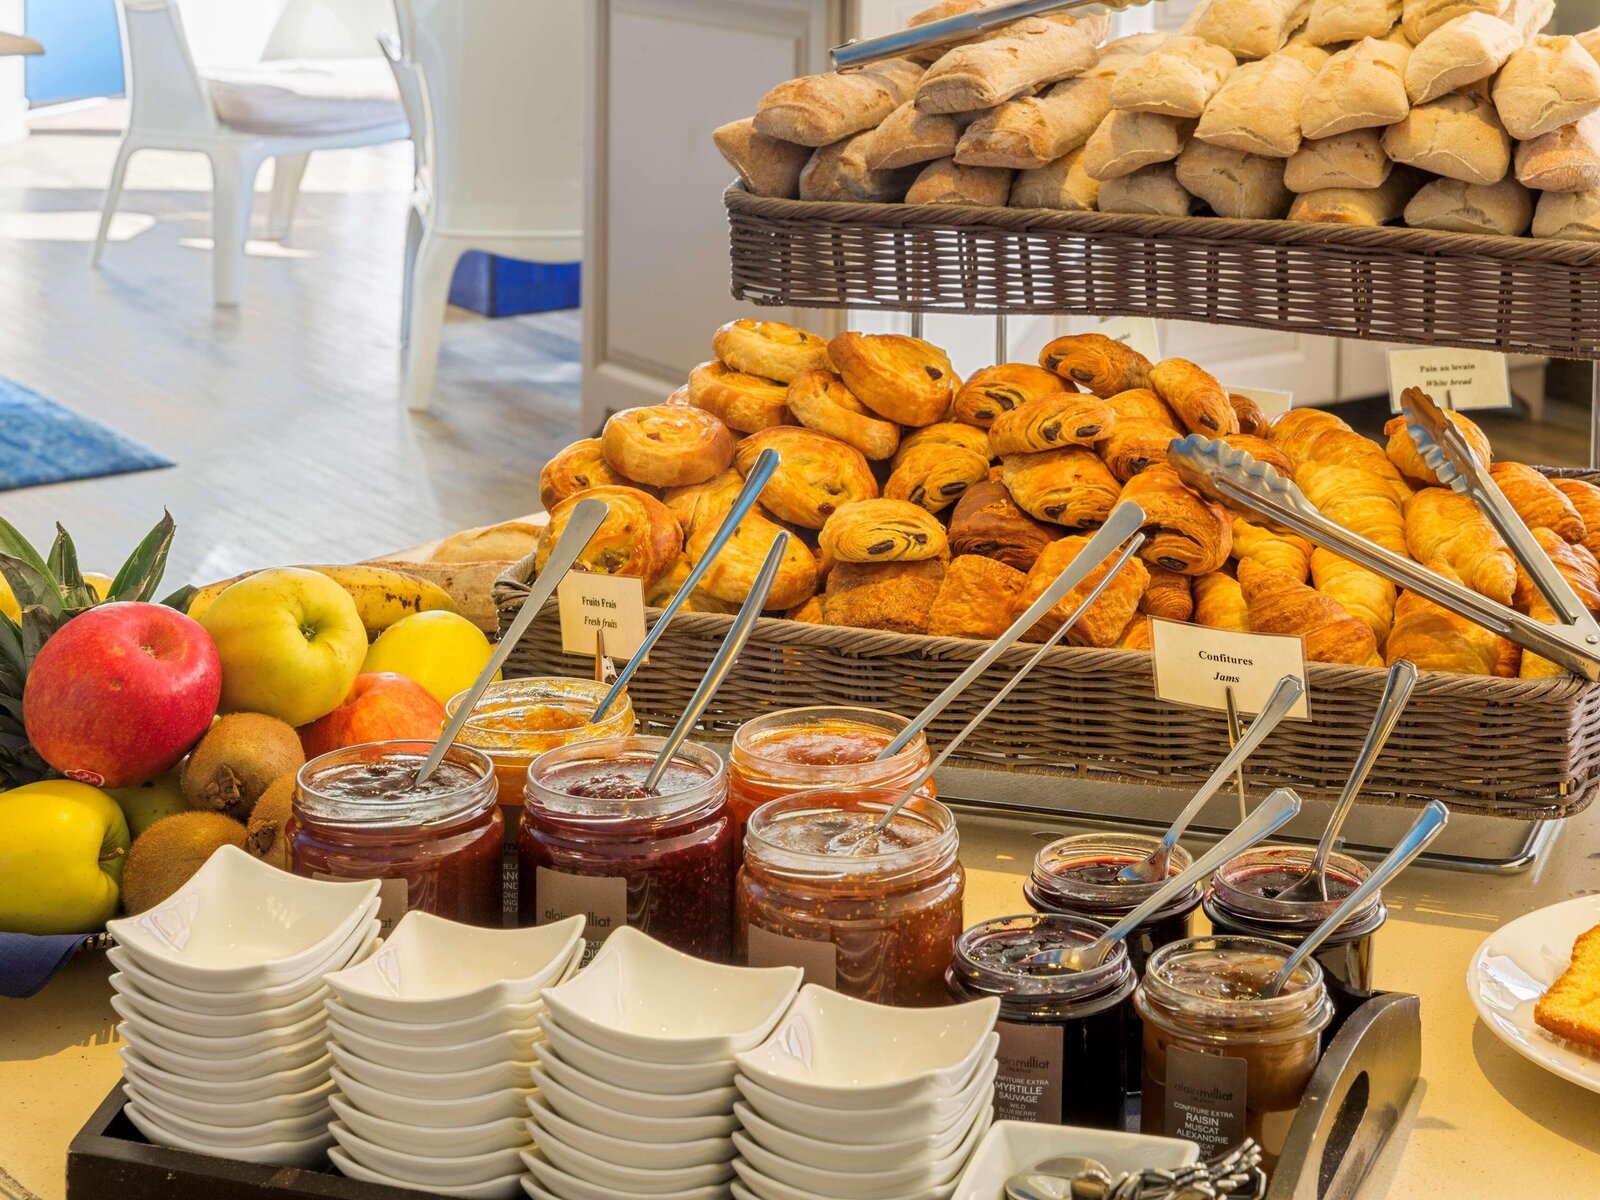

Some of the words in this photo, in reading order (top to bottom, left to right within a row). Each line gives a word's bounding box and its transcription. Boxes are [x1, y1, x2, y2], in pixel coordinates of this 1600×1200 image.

[1420, 365, 1437, 373] Pain
[1451, 363, 1475, 371] levain
[1426, 378, 1447, 386] White
[1450, 377, 1472, 386] bread
[582, 596, 600, 607] Fruits
[601, 598, 617, 609] Frais
[584, 616, 601, 627] Fresh
[601, 618, 618, 629] fruits
[1198, 650, 1253, 666] Confitures
[1213, 671, 1240, 683] Jams
[995, 1081, 1043, 1095] MYRTILLE
[1026, 1079, 1049, 1087] EXTRA
[999, 1091, 1038, 1103] SAUVAGE
[999, 1107, 1037, 1116] BLUEBERRY
[1010, 1102, 1025, 1110] WILD
[1173, 1101, 1209, 1116] CONFITURE
[1210, 1110, 1234, 1119] EXTRA
[1185, 1112, 1219, 1126] RAISIN
[1184, 1122, 1220, 1135] MUSCAT
[1176, 1128, 1229, 1145] ALEXANDRIE
